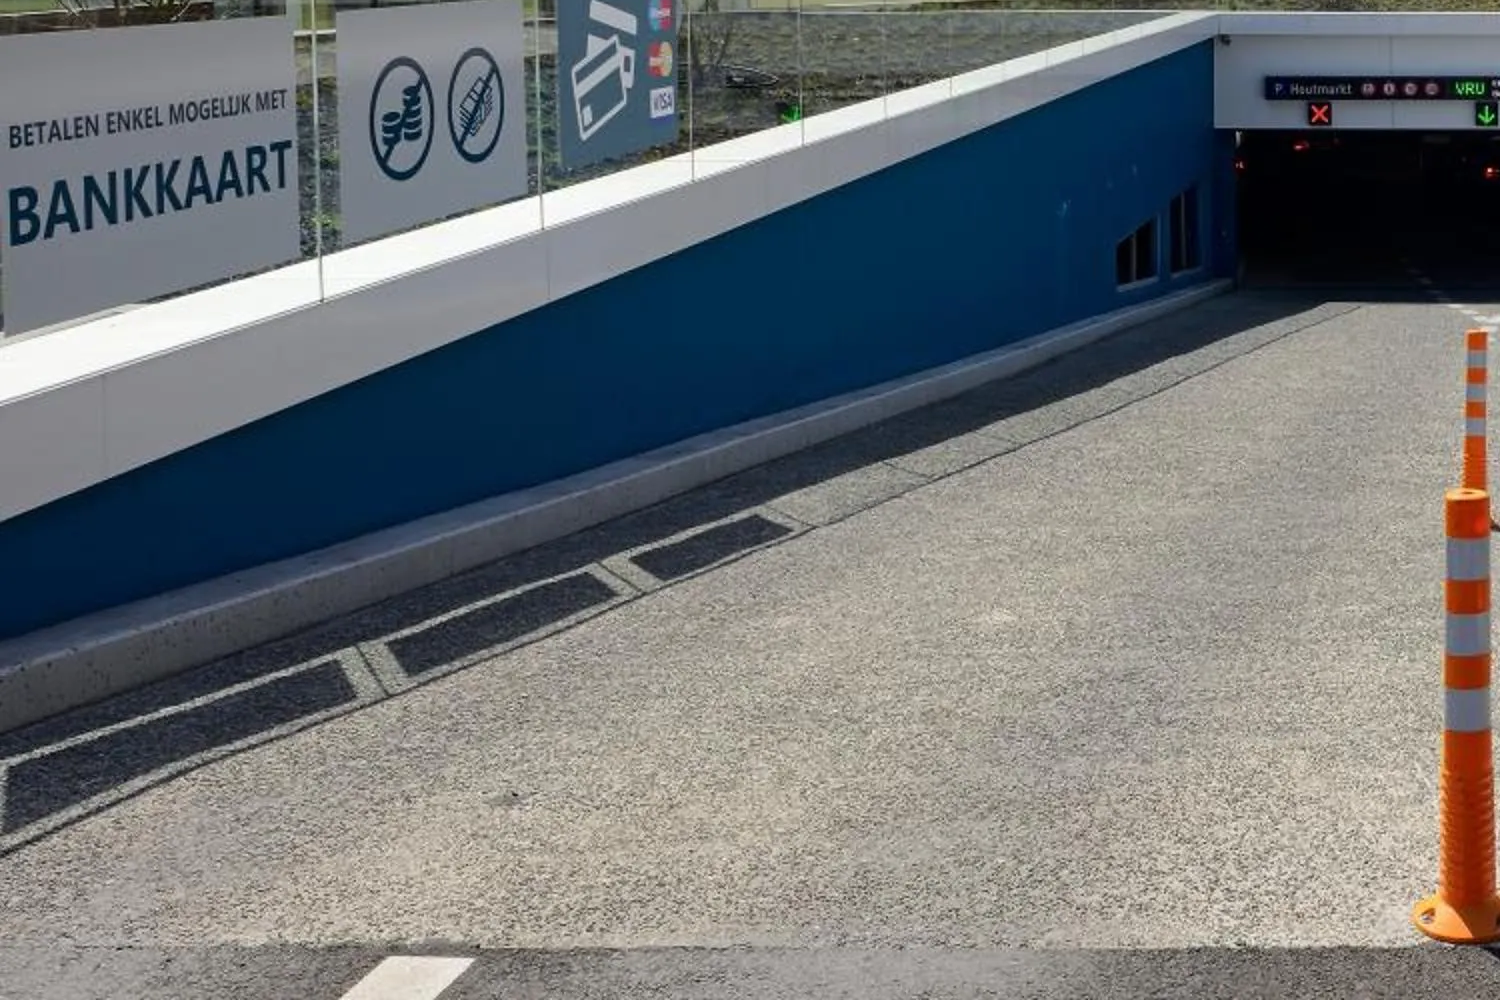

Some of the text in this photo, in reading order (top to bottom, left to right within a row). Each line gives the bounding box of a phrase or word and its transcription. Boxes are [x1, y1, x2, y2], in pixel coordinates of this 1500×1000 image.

[9, 89, 288, 149] BETALEN ENKEL MOGELIJK MET
[9, 140, 293, 247] BANKKAART
